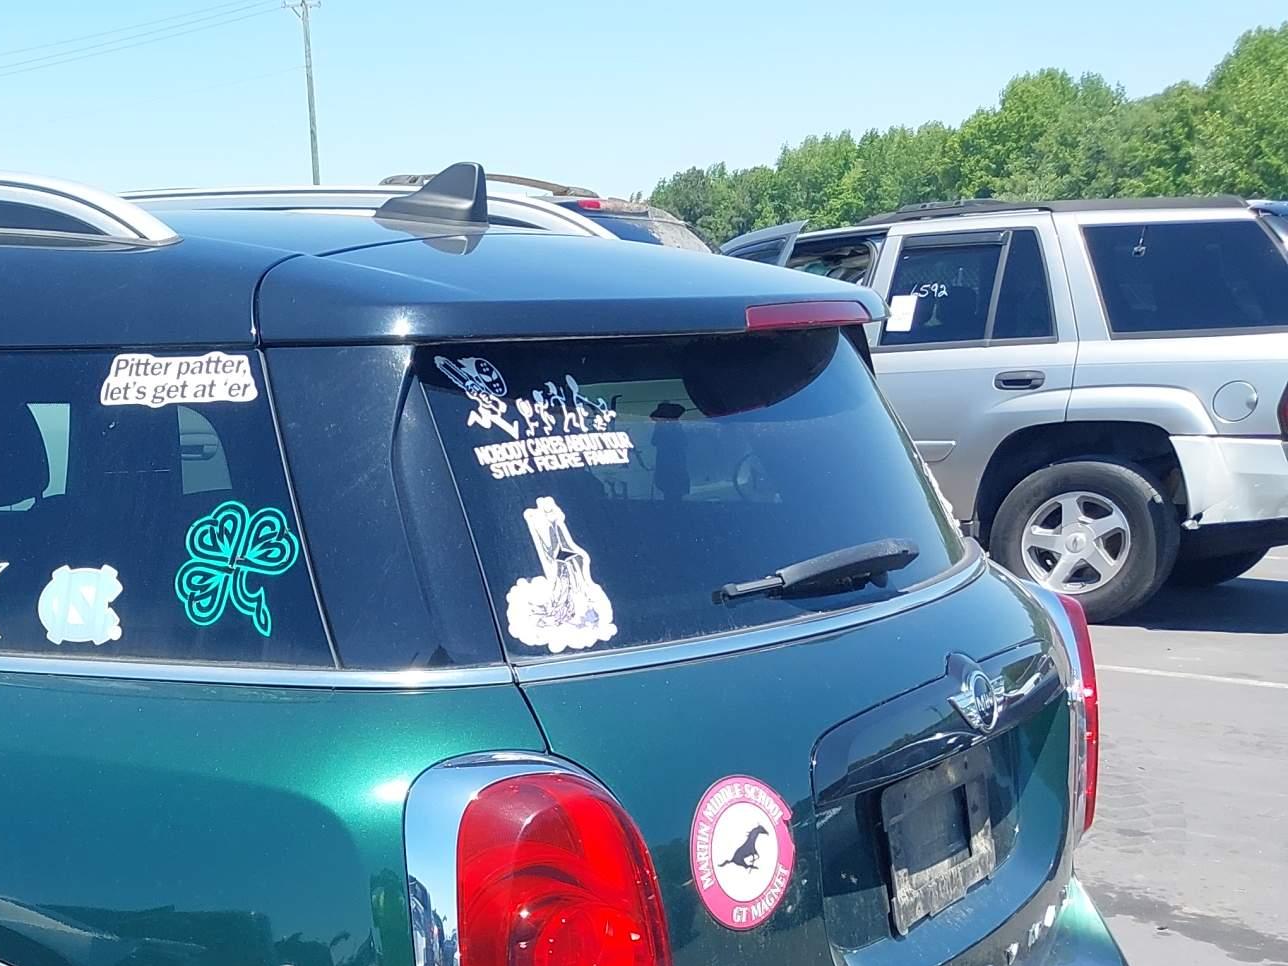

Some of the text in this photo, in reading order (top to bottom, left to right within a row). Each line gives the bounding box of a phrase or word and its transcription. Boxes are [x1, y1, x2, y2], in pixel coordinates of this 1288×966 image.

[114, 356, 247, 380] Pitter patter,
[103, 381, 147, 401] let's
[150, 380, 189, 404] get
[193, 379, 216, 398] at
[474, 440, 528, 466] NOBODY
[490, 458, 535, 479] STICK
[534, 452, 585, 472] FIGURE
